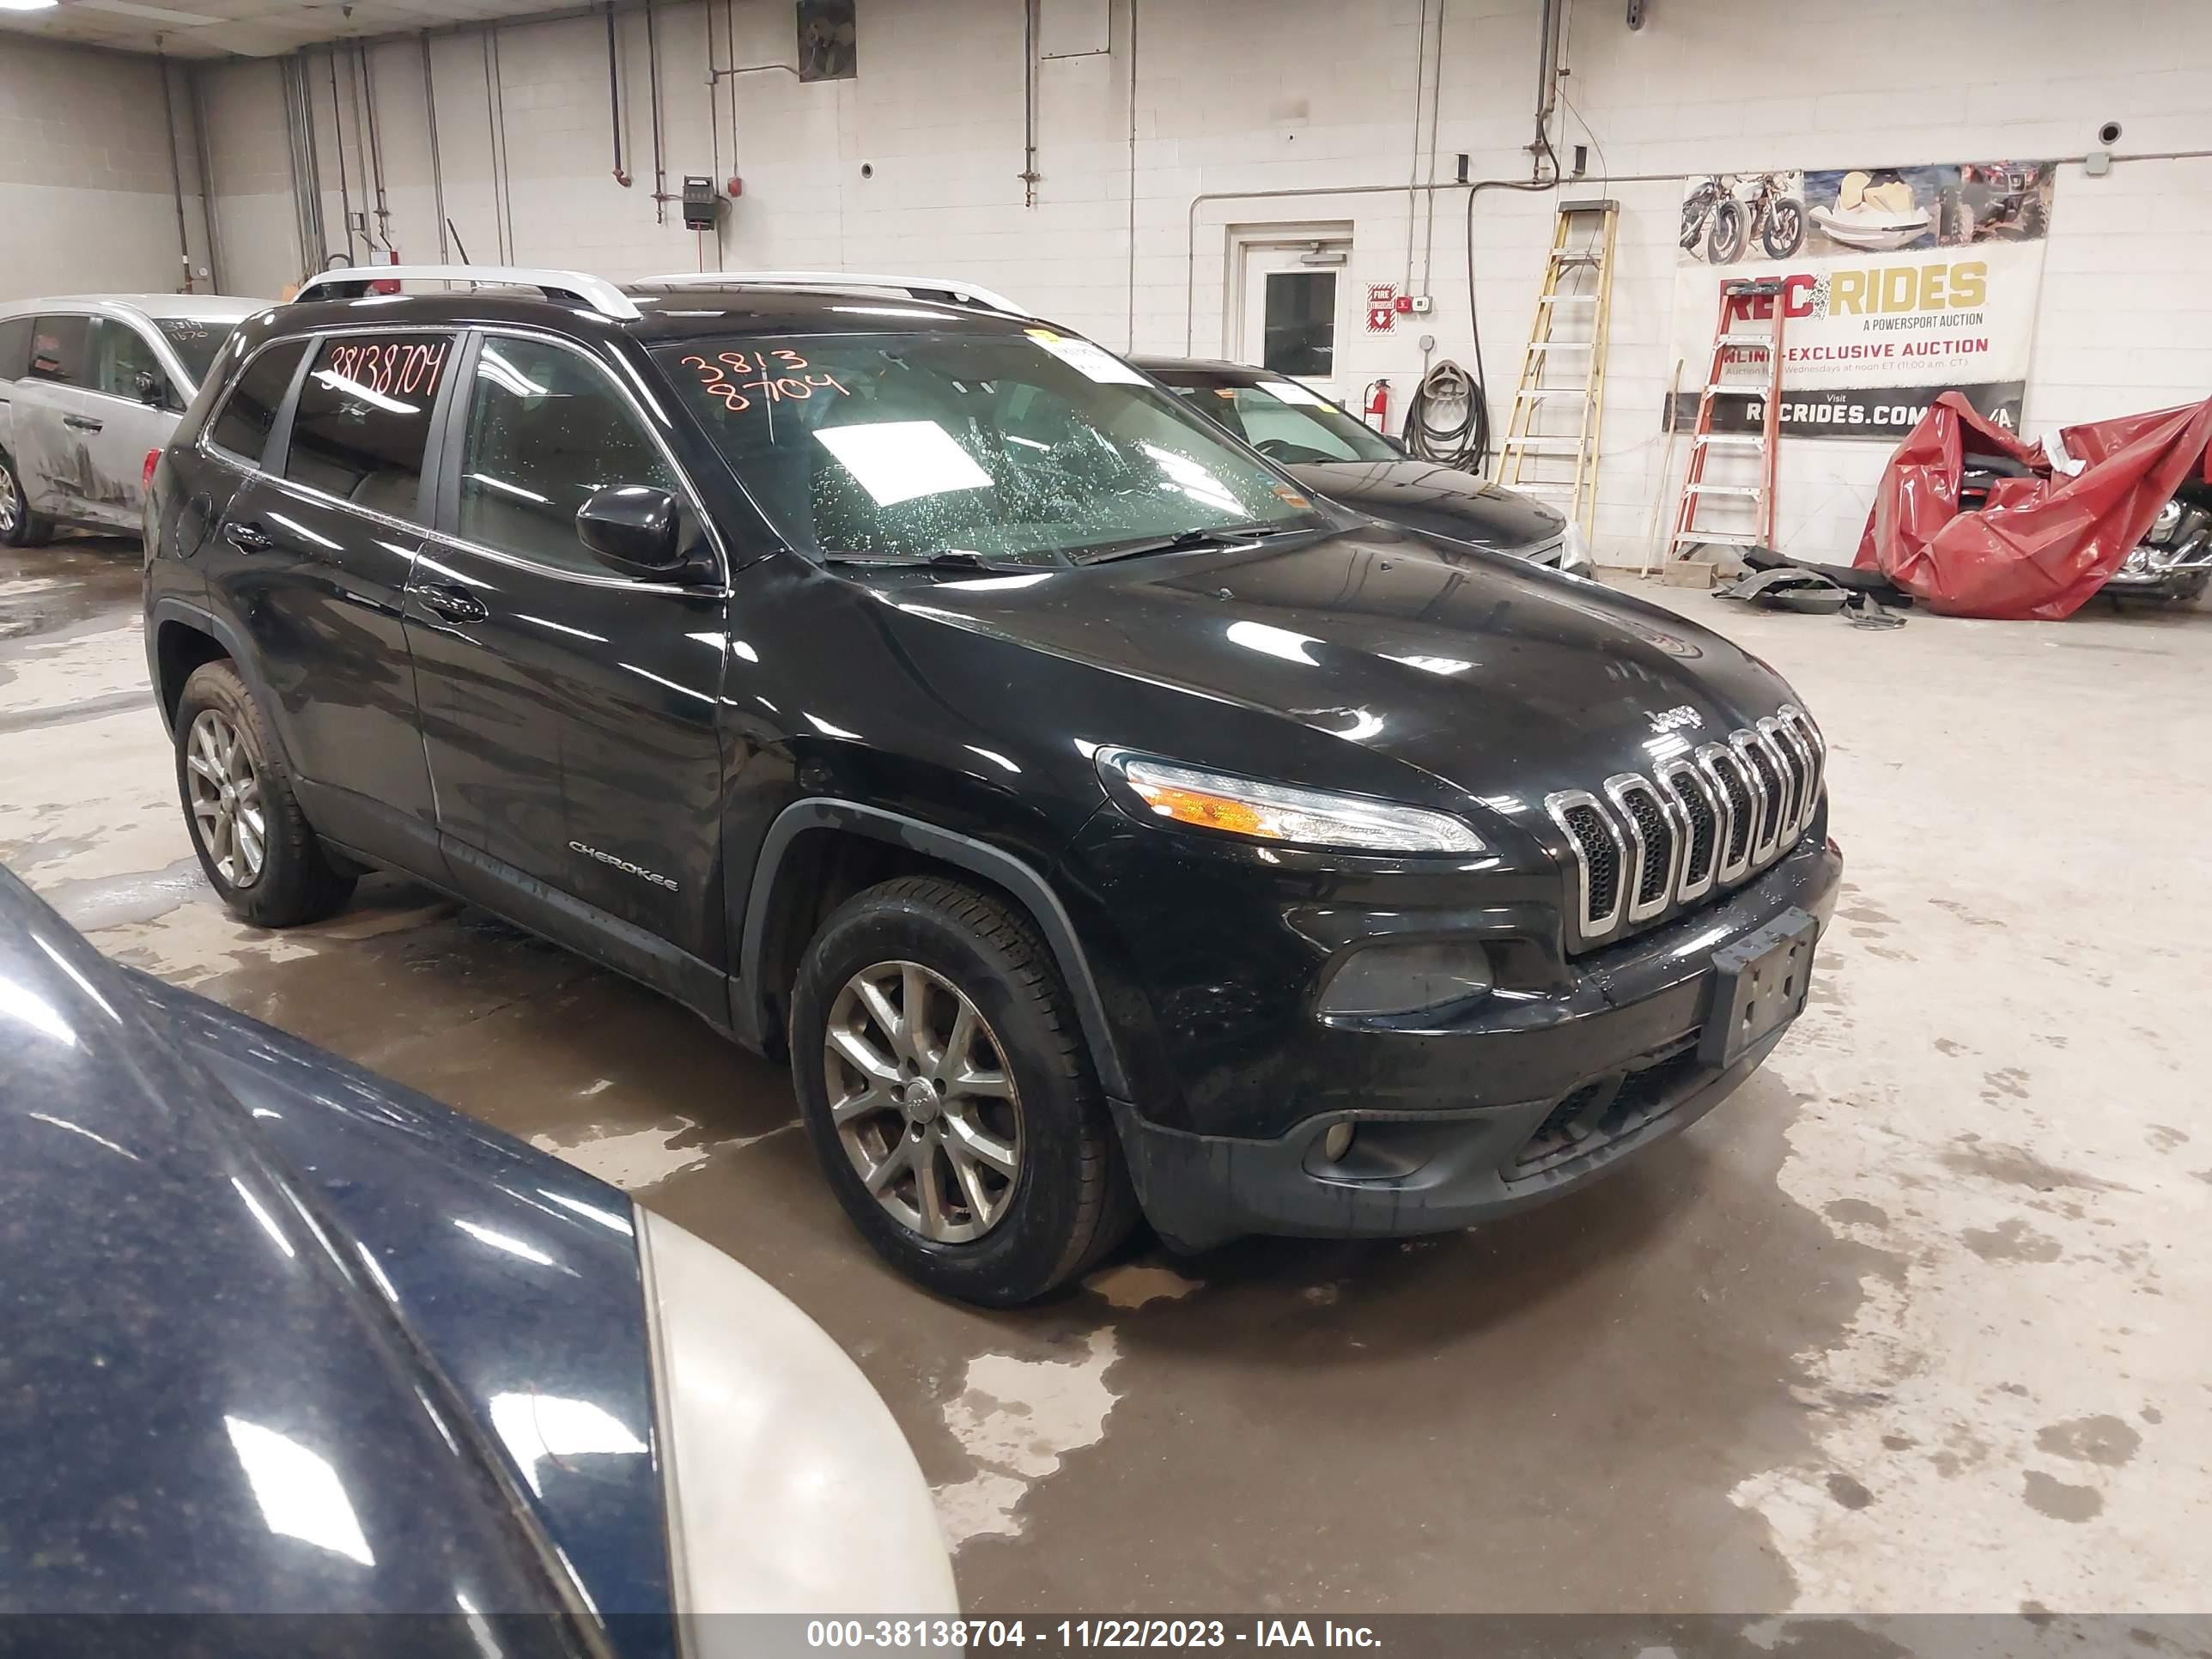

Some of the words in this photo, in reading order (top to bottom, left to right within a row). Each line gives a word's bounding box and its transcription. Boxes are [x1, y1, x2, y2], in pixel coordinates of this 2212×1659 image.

[1374, 289, 1389, 300] FIRE
[1829, 261, 1987, 316] RIDES
[1863, 319, 1870, 331] A
[1873, 316, 1938, 331] POWERSPORT
[1940, 313, 1984, 327] AUCTION
[1902, 338, 1989, 356] AUCTION
[321, 343, 447, 397] 38138704
[681, 349, 809, 383] 3813
[1725, 366, 1760, 376] Auction
[1784, 362, 1841, 374] Wednesdays
[1845, 362, 1854, 371] at
[1855, 362, 1879, 371] noon
[1882, 361, 1895, 370] ET
[1949, 357, 1969, 367] CT)
[707, 374, 851, 410] 8704
[1826, 393, 1846, 403] Visit
[1746, 402, 1929, 426] RCRIDES.COM
[568, 841, 679, 892] CHEROKEE
